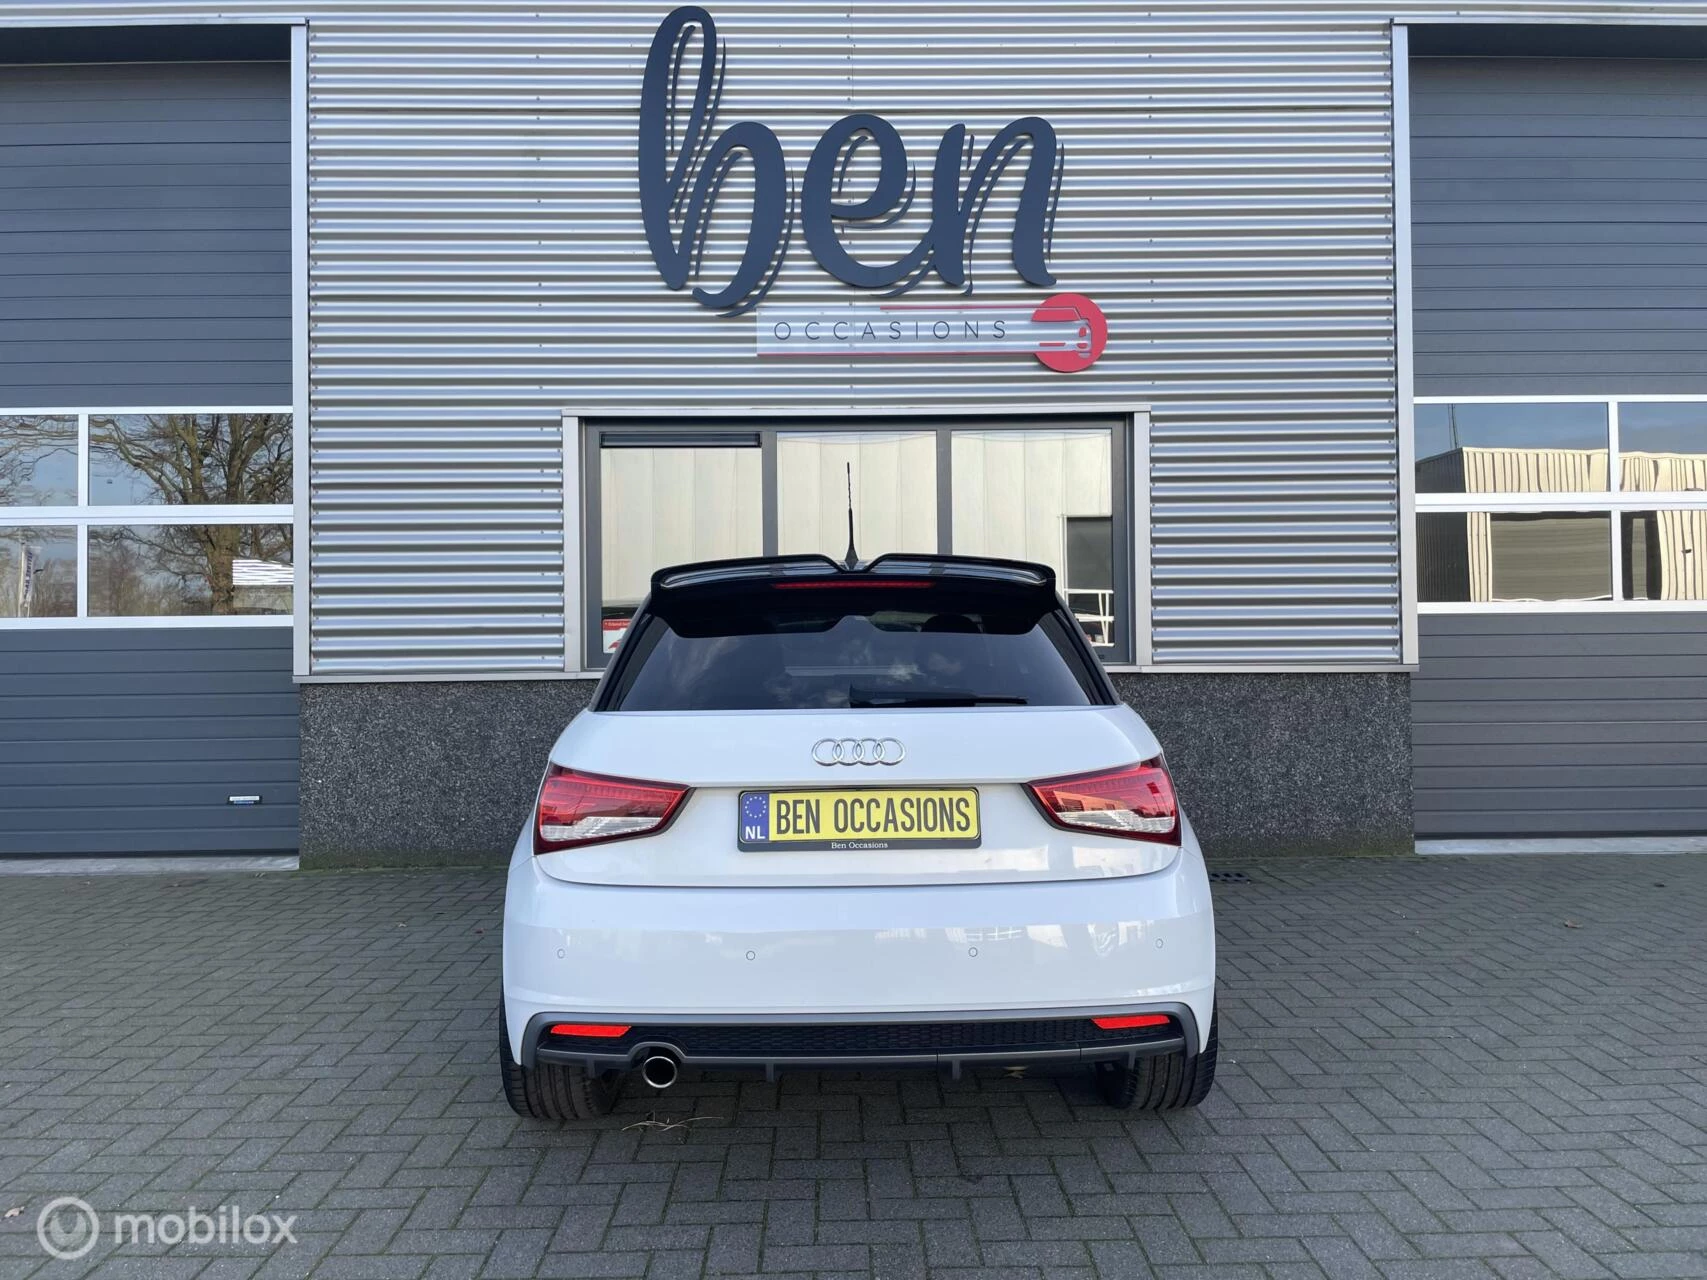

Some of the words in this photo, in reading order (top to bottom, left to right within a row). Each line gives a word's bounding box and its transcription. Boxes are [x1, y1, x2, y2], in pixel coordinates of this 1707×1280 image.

[638, 5, 1063, 315] ben
[773, 319, 1006, 341] OCCASIONS
[776, 799, 820, 835] BEN
[834, 797, 971, 833] OCCASIONS
[745, 826, 766, 840] NL
[848, 841, 889, 849] Occasions
